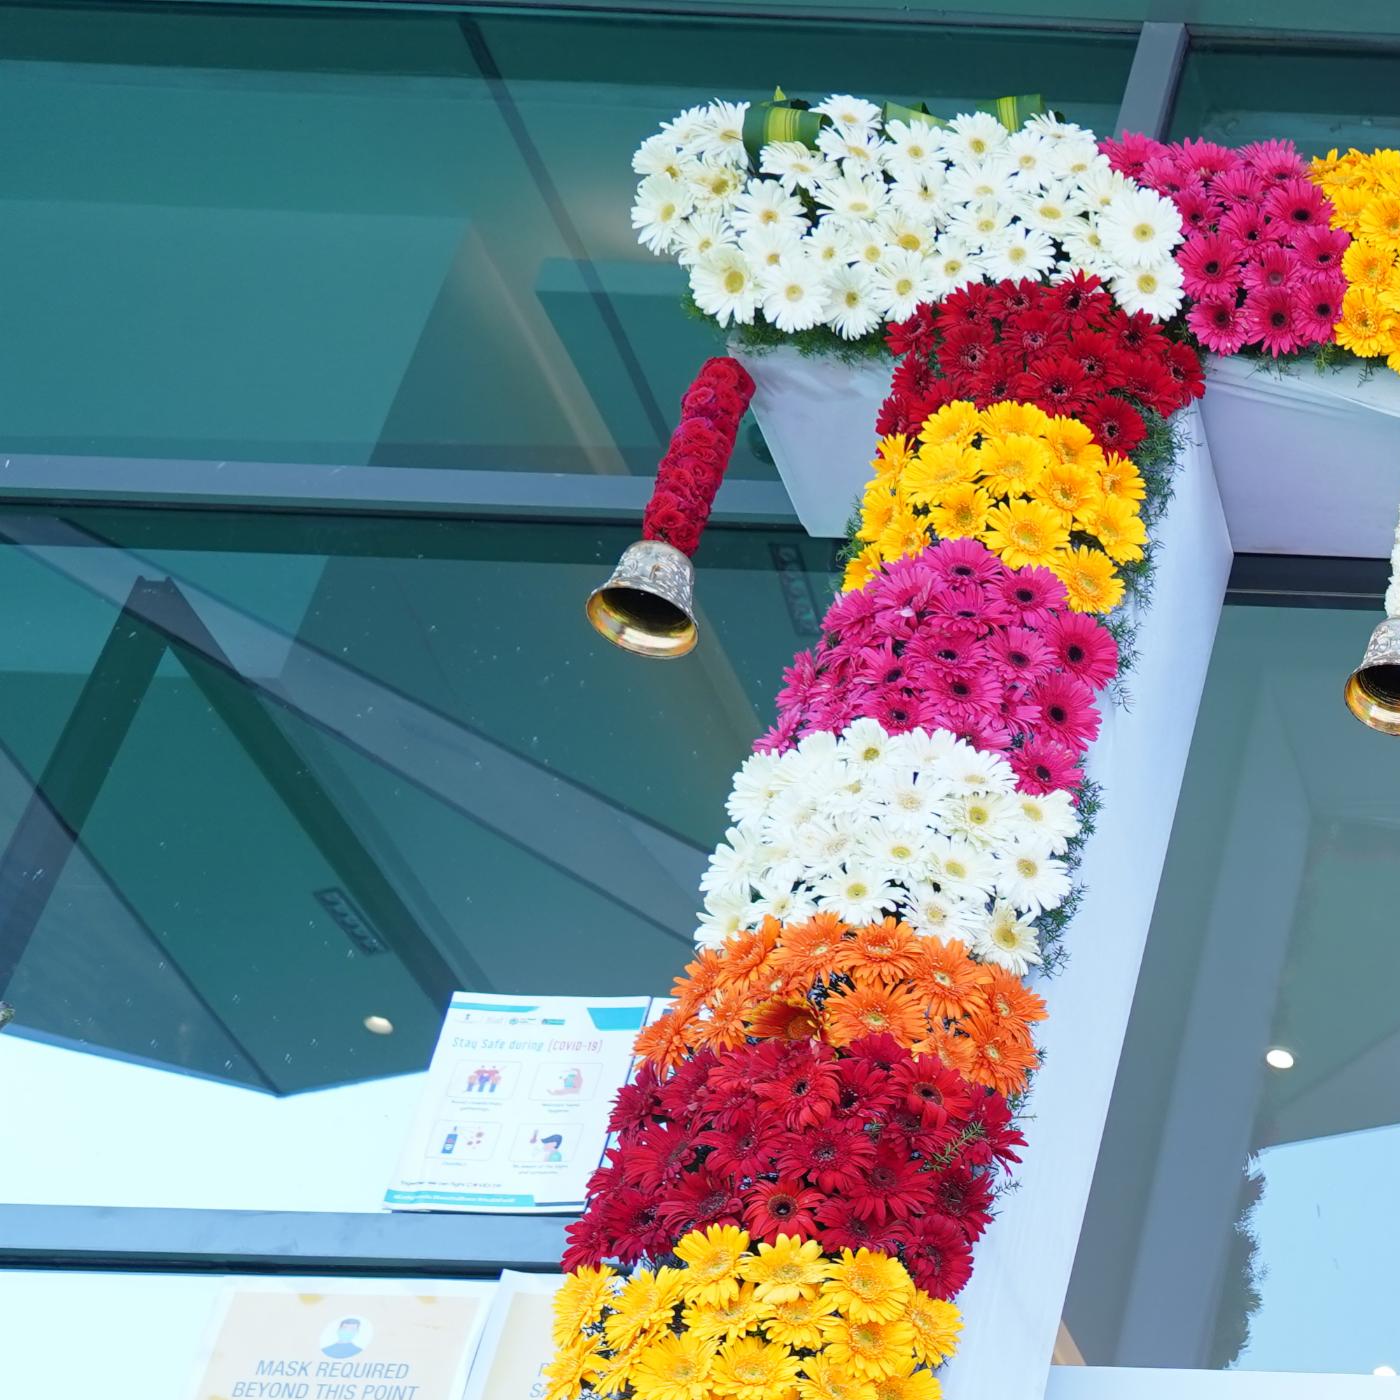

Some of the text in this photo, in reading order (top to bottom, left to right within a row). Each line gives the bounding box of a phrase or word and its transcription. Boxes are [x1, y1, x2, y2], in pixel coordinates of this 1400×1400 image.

[452, 1036, 478, 1050] Stay
[480, 1038, 506, 1050] Safe
[508, 1038, 545, 1052] during
[255, 1359, 409, 1379] MASK REQUIRED
[231, 1381, 311, 1399] BEYOND
[316, 1383, 358, 1400] THIS
